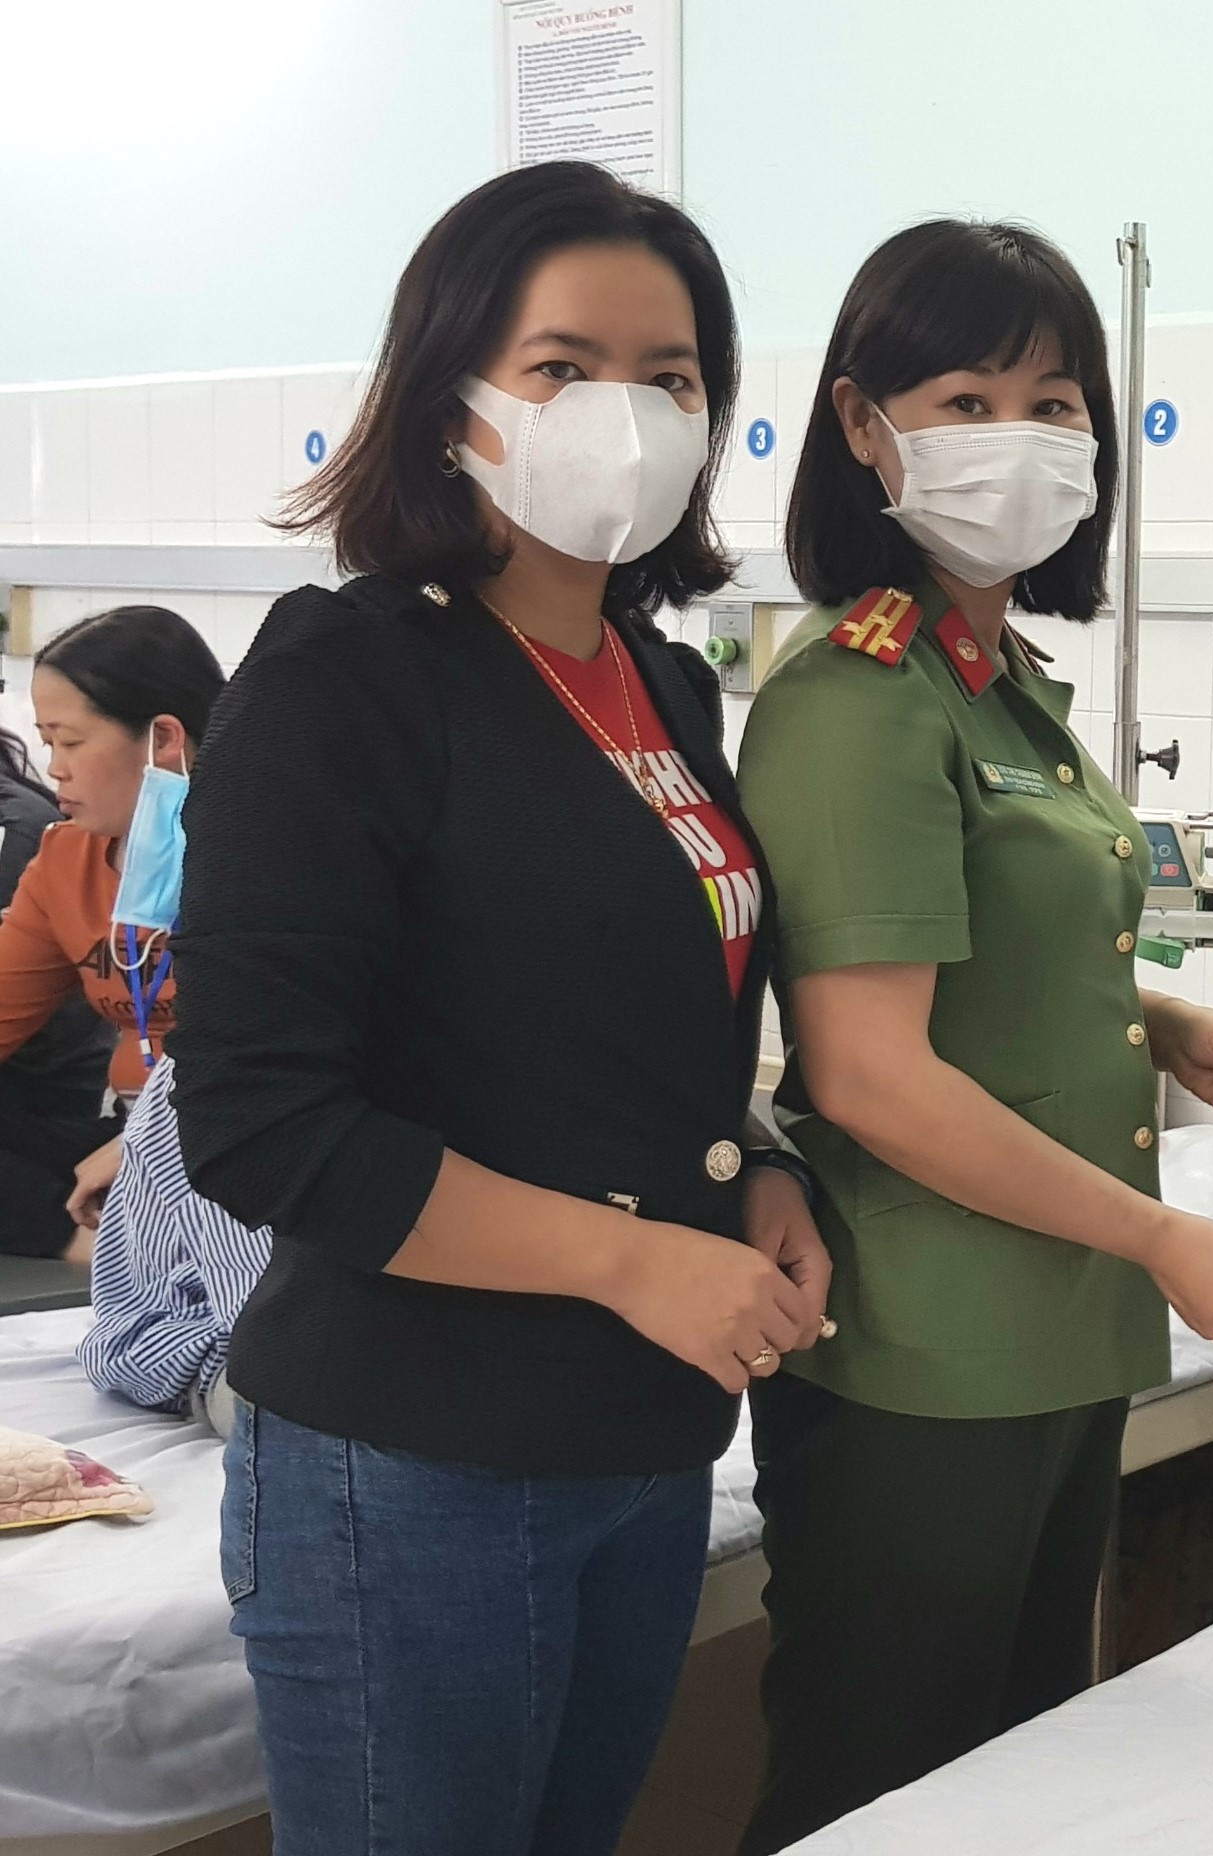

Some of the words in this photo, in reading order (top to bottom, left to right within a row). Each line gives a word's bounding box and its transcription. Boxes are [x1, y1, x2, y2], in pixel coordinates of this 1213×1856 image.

[1154, 409, 1167, 436] 2
[311, 437, 319, 458] 4
[756, 427, 766, 451] 3
